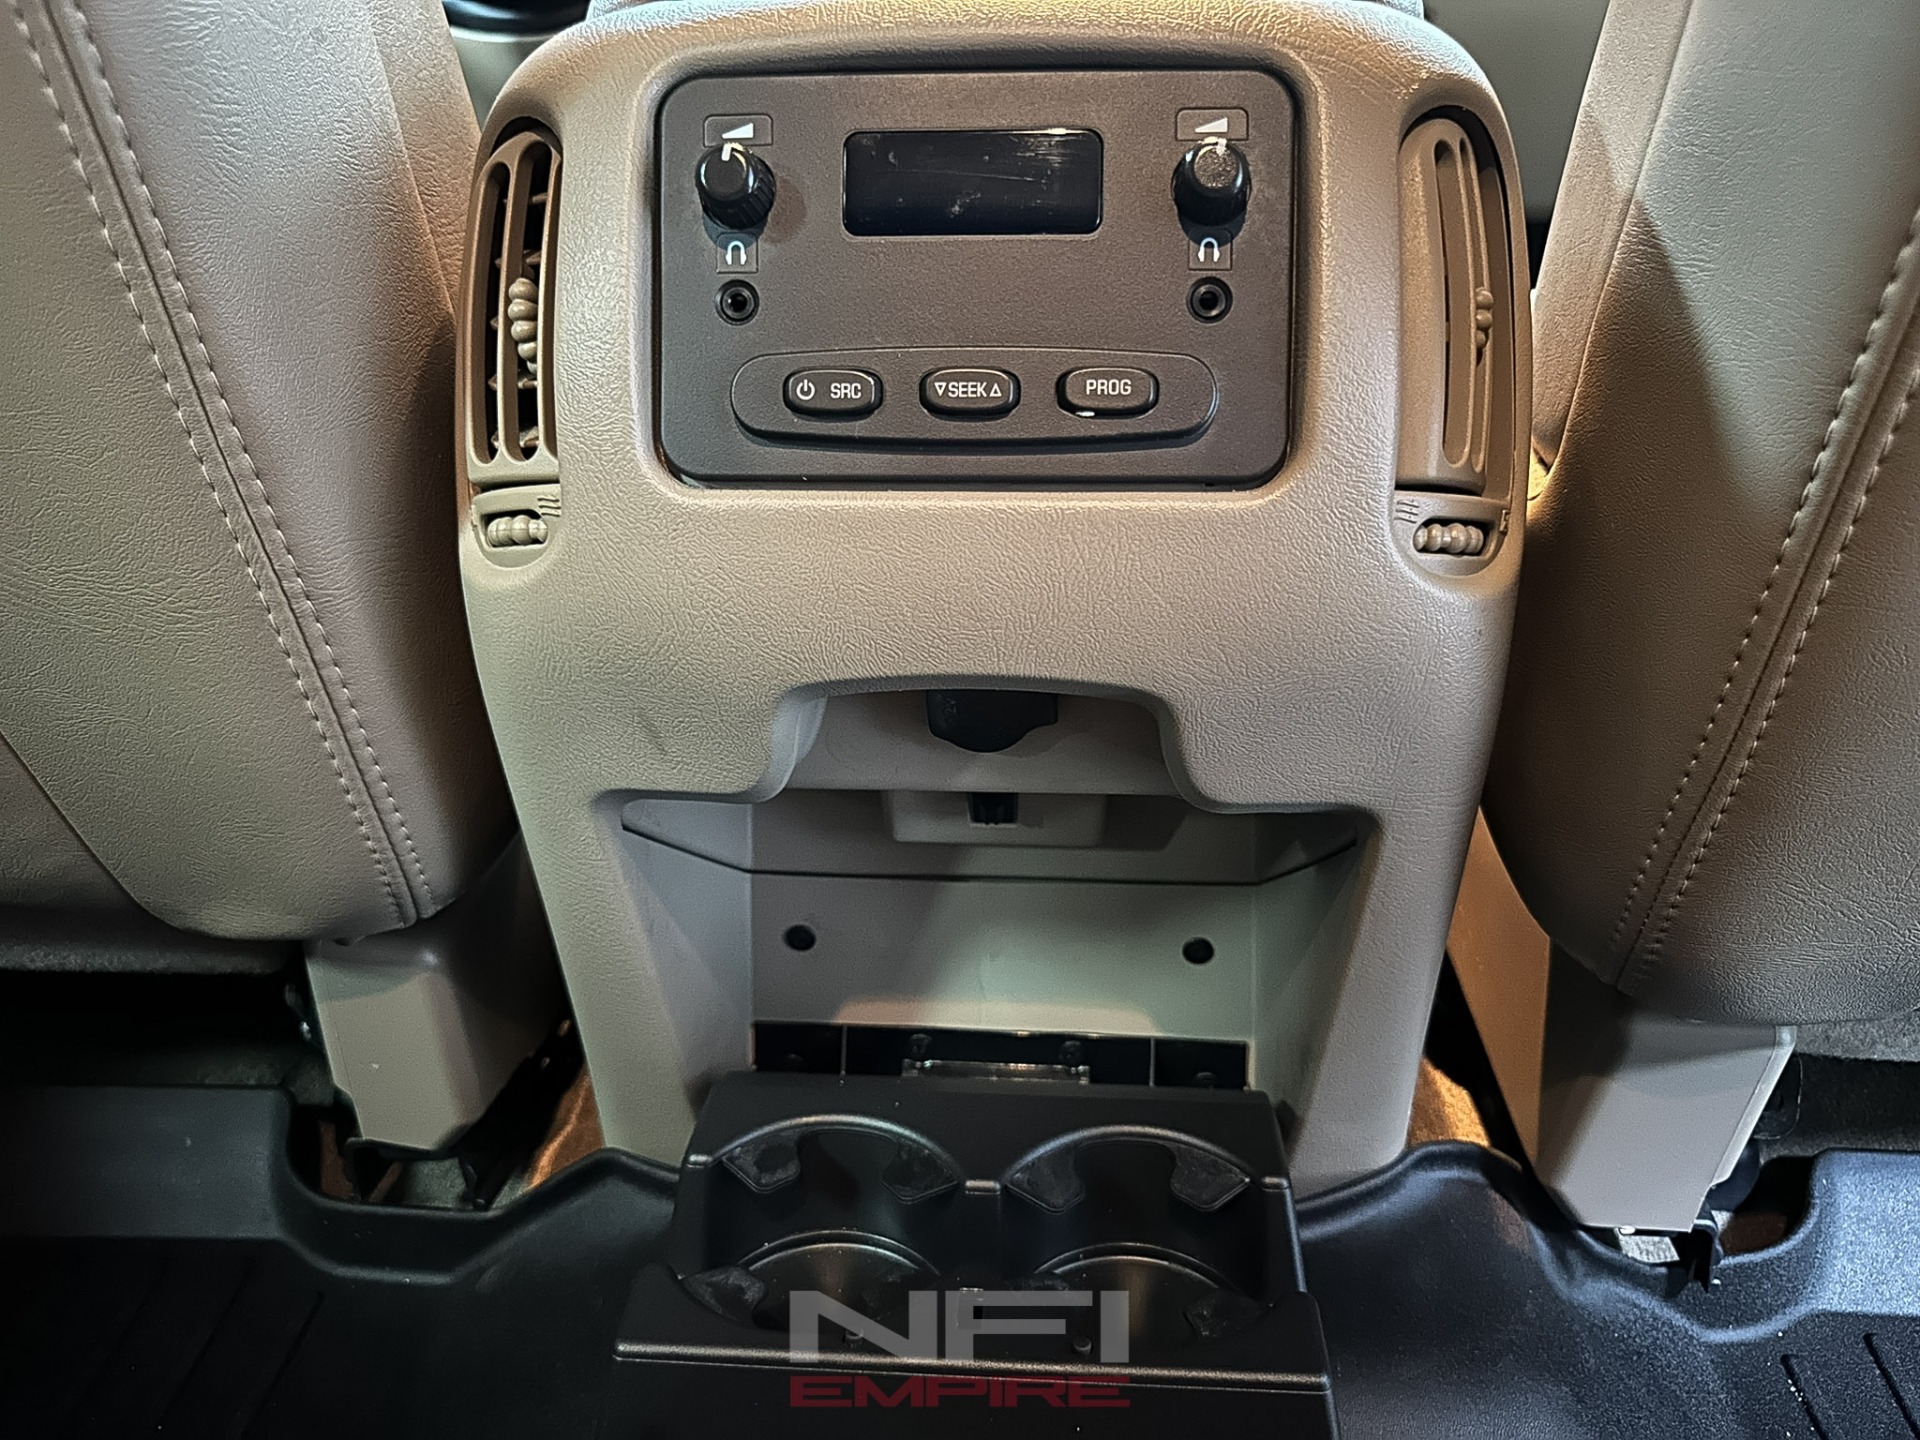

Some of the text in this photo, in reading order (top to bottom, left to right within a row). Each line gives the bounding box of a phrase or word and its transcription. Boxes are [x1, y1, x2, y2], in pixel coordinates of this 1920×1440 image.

[829, 385, 862, 399] SRC
[947, 382, 987, 397] SEEK
[1086, 380, 1131, 395] PROG
